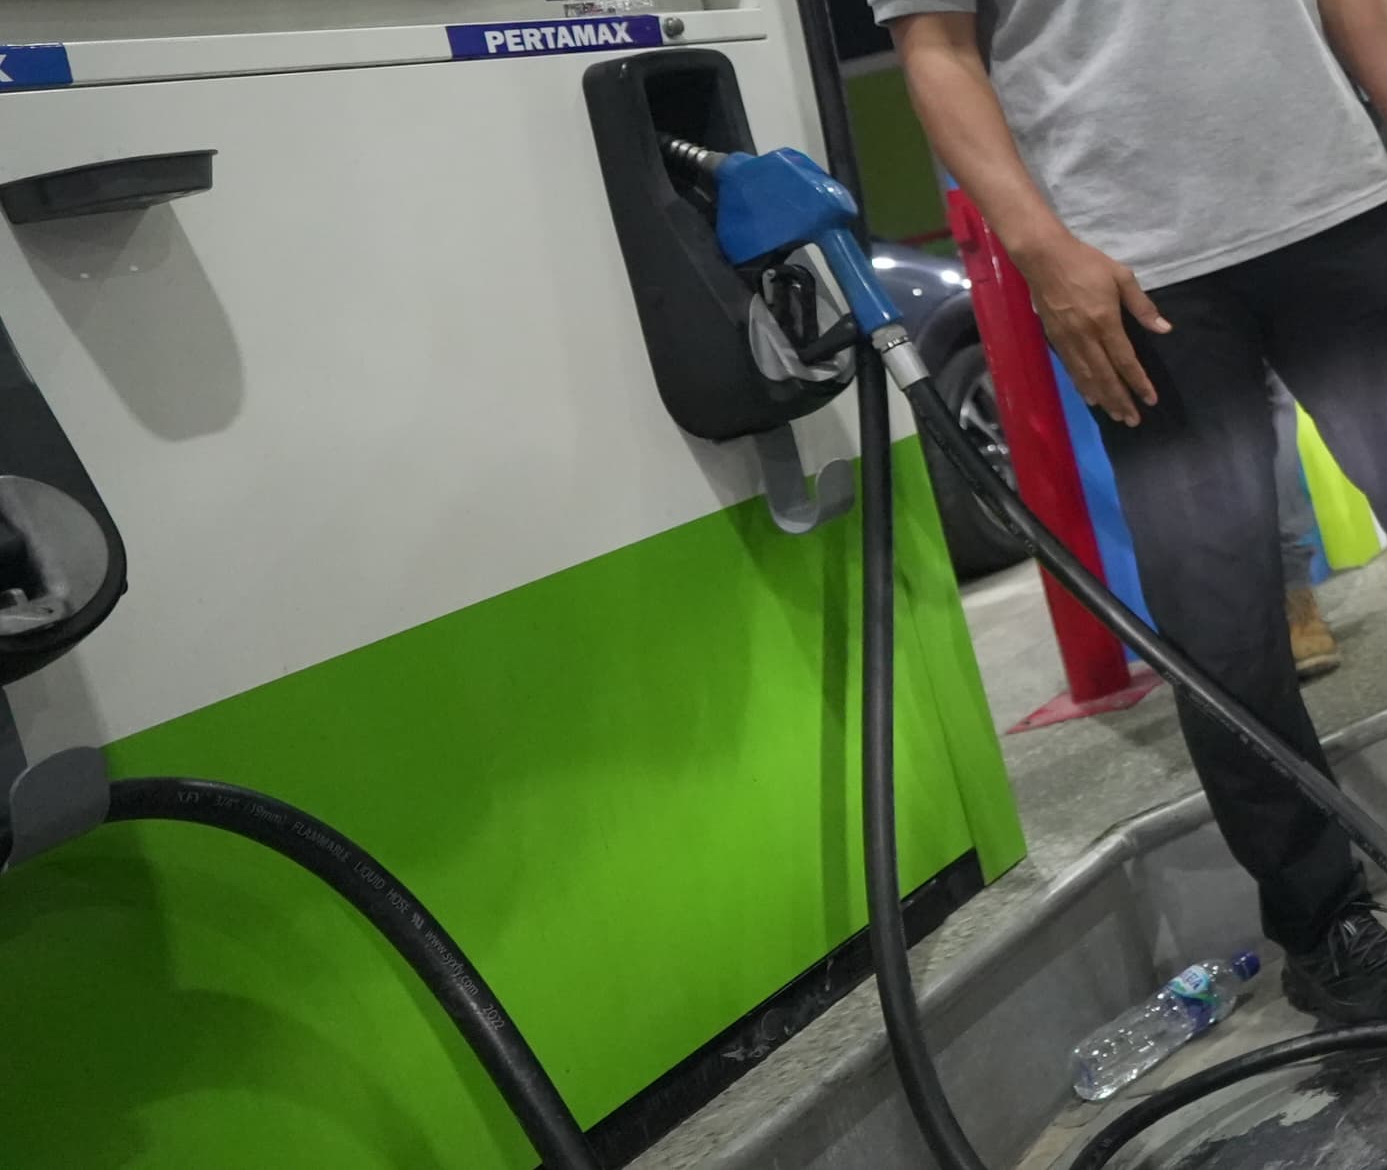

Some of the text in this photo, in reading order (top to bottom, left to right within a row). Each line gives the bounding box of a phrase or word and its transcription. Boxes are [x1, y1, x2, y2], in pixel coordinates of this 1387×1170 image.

[484, 21, 633, 54] PERTAMAX
[291, 821, 352, 863] FLAMMABLE
[353, 862, 385, 890] LIQUID
[386, 888, 410, 914] HOSE
[483, 1003, 505, 1031] 2022
